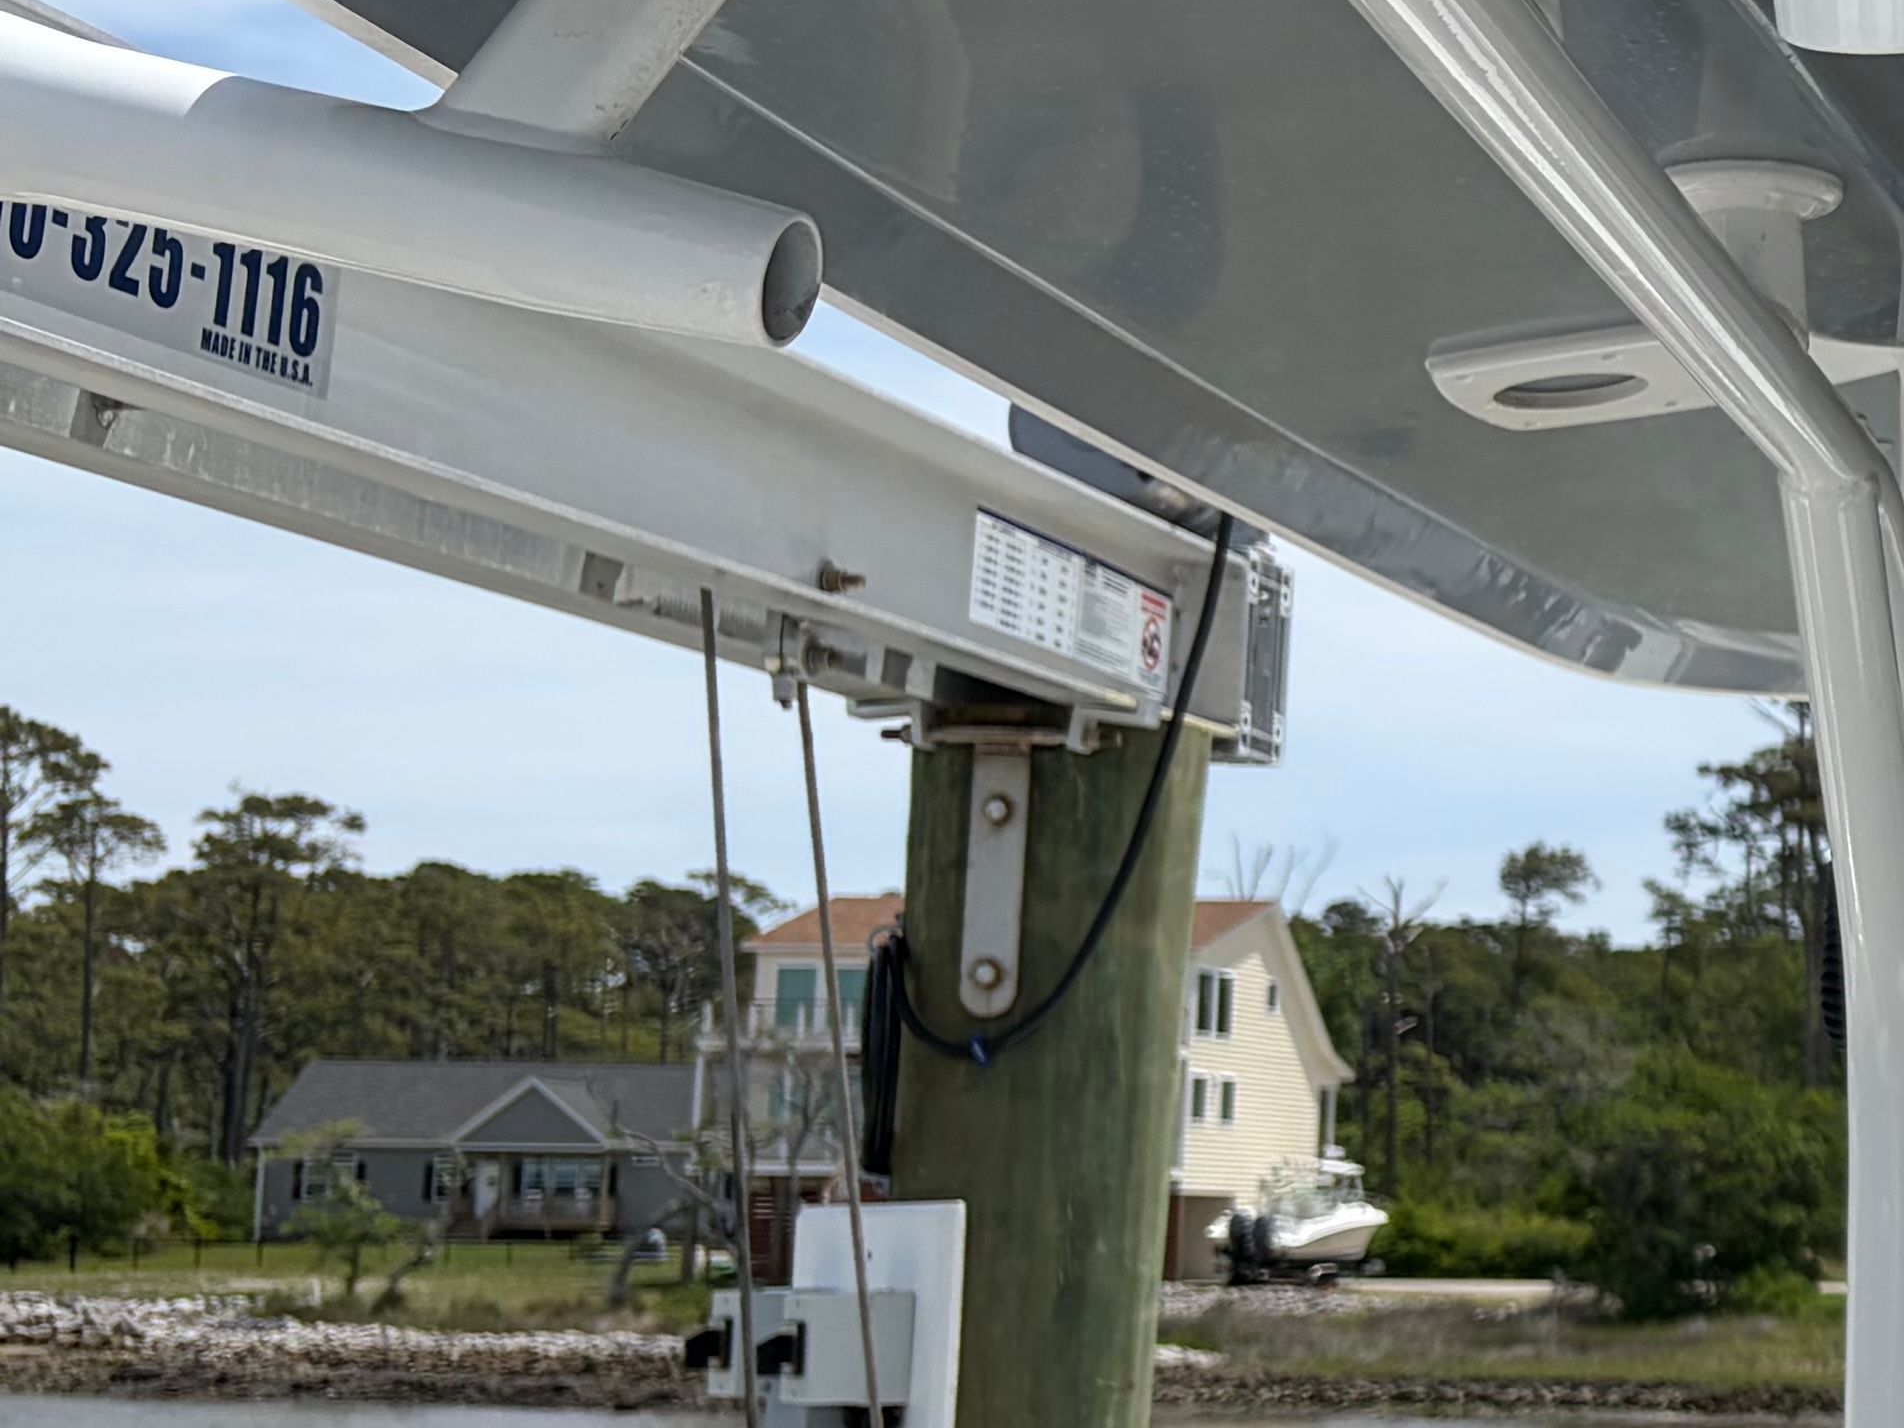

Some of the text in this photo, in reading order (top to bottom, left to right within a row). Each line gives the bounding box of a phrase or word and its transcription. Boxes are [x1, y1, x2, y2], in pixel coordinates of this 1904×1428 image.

[0, 201, 323, 357] 0-325-1116
[200, 328, 313, 387] MADE IN THE U.S.A.
